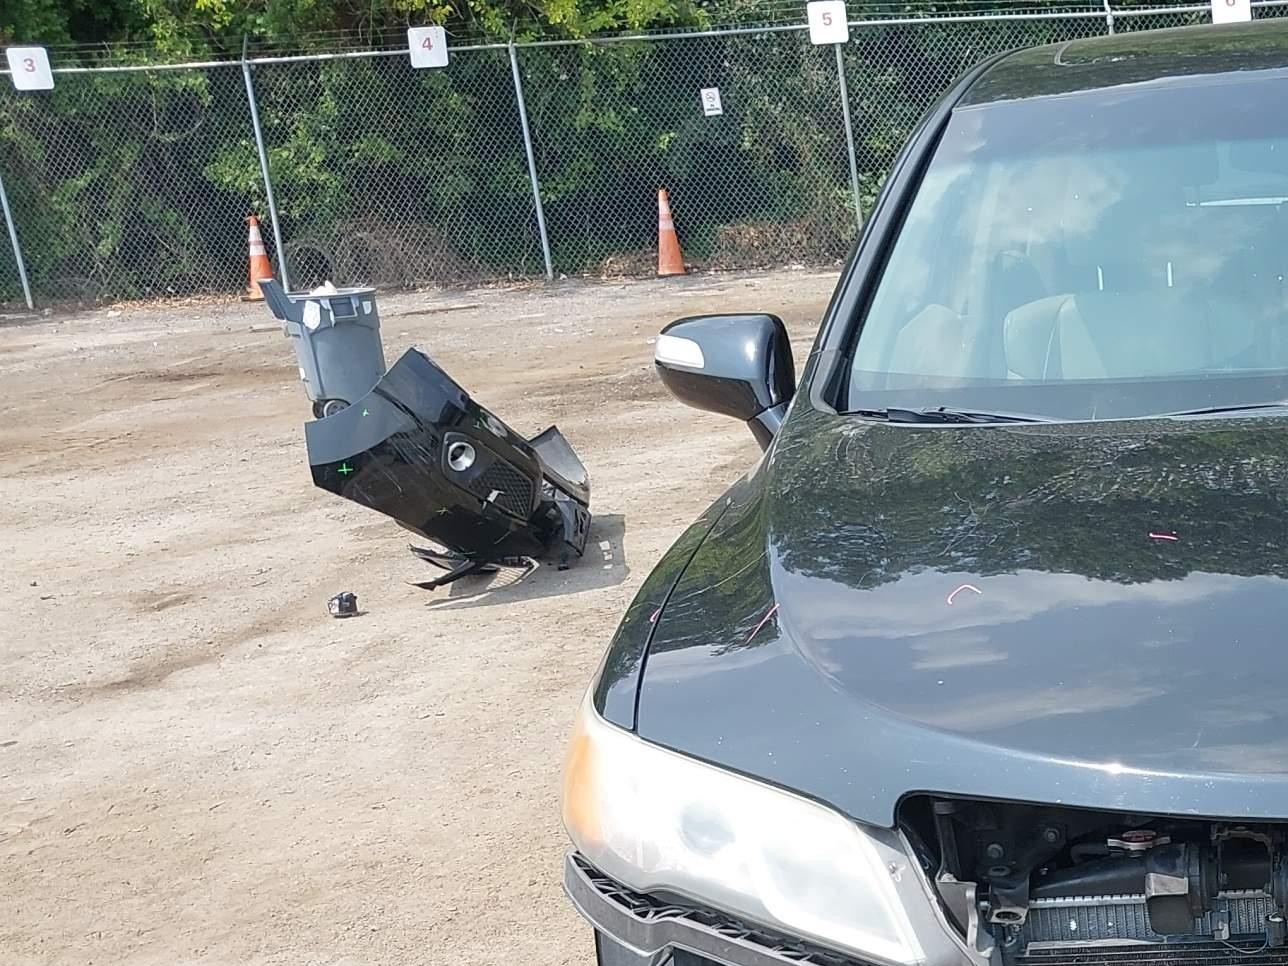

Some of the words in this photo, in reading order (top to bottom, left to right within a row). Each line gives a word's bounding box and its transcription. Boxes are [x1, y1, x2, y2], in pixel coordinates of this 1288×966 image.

[822, 11, 833, 26] 5
[422, 36, 434, 51] 4
[23, 57, 37, 73] 3
